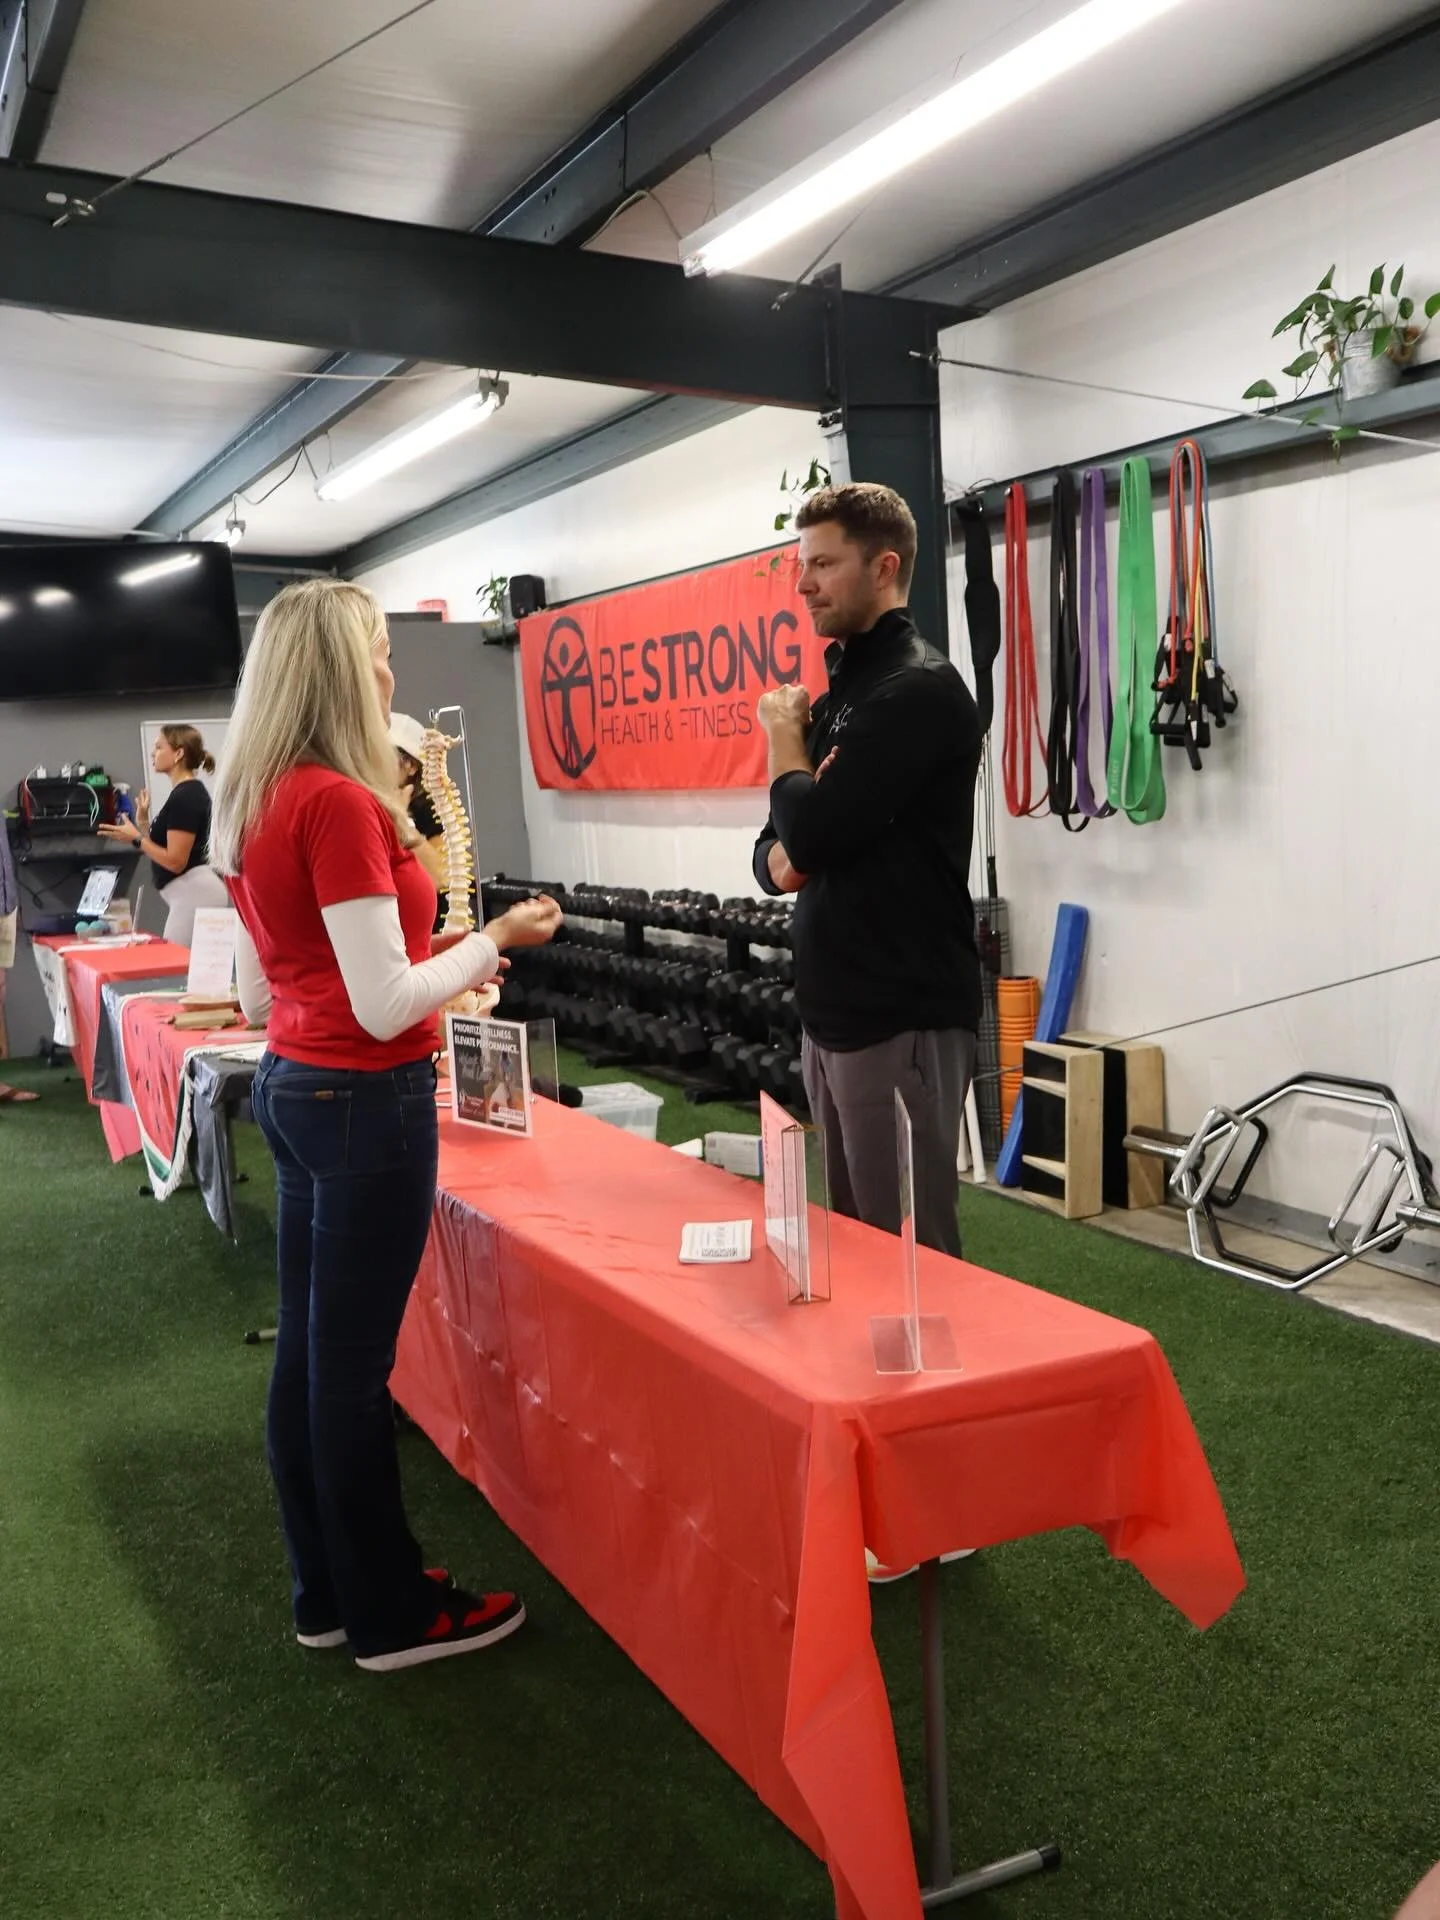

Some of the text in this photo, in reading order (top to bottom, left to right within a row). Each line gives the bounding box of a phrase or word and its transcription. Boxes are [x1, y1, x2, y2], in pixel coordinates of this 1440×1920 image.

[599, 609, 801, 709] BESTRONG
[601, 701, 752, 745] HEALTH & FITNESS
[454, 1035, 476, 1047] ELEVATE
